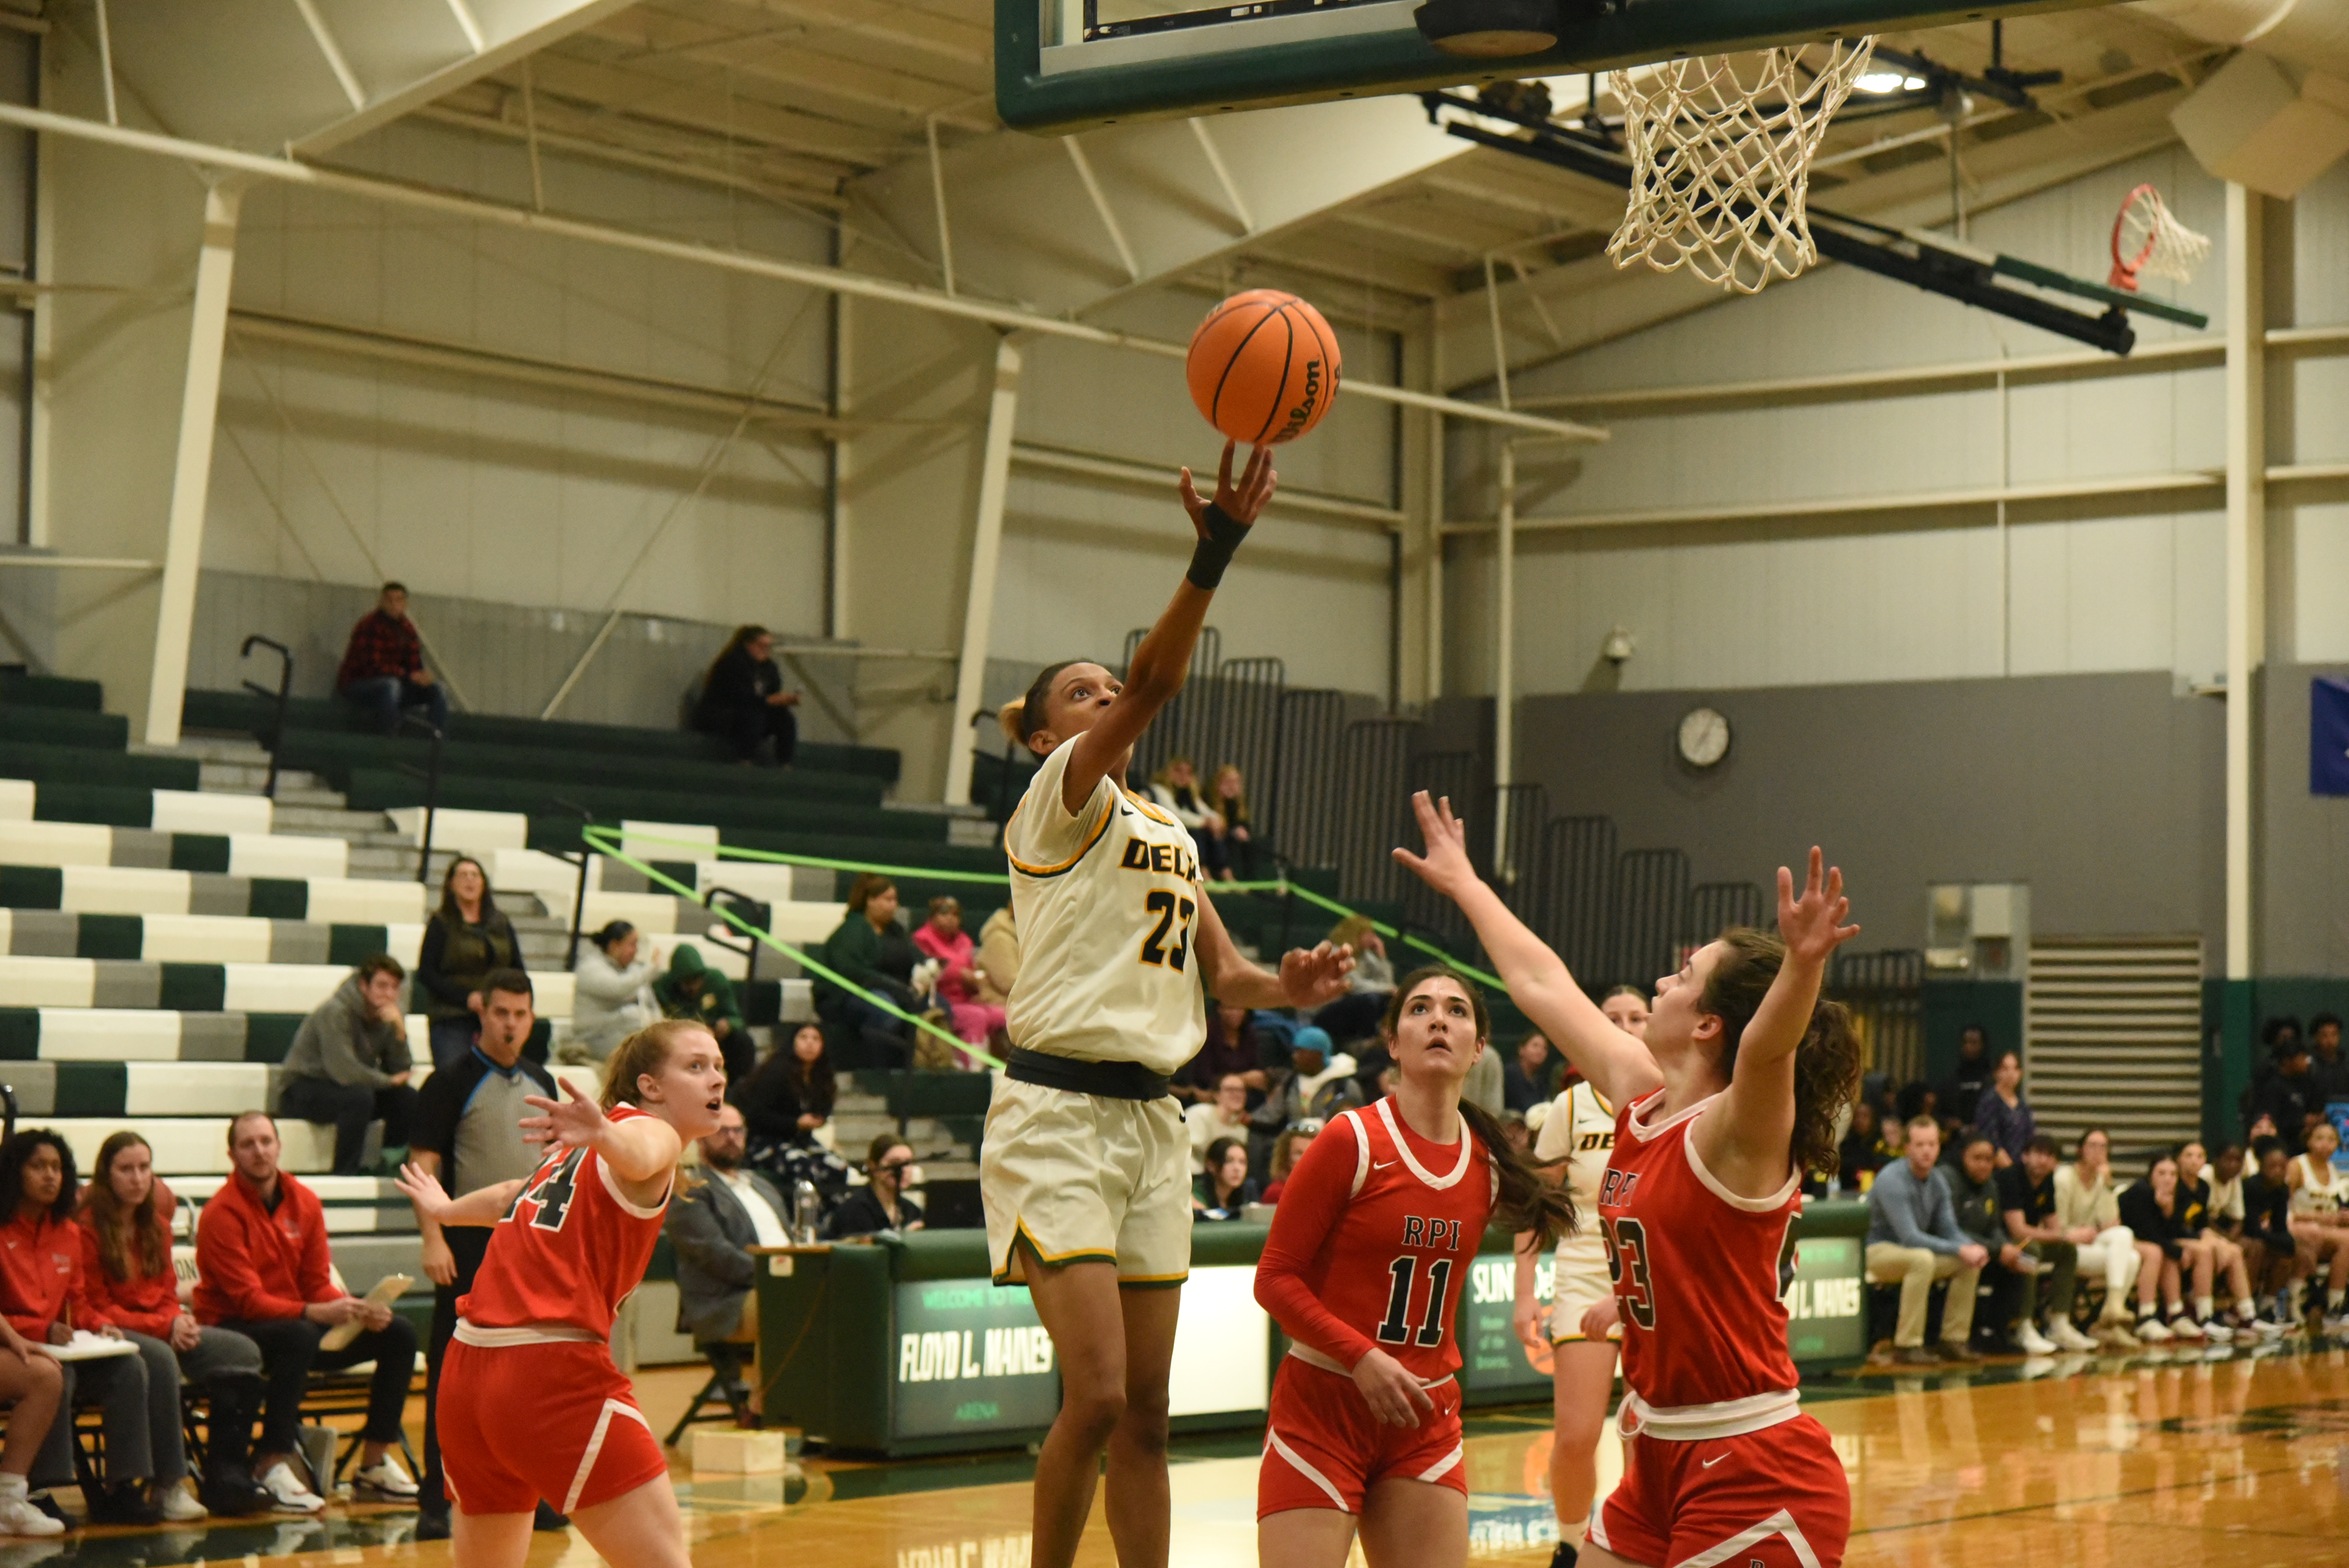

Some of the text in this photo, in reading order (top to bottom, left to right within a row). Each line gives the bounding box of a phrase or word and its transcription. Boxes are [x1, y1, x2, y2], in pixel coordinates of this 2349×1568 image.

[1272, 359, 1320, 442] Wilson
[1138, 888, 1196, 976] 23
[1401, 1214, 1463, 1251] RPI
[1376, 1255, 1453, 1348] 11
[899, 1330, 961, 1383] FLOYD
